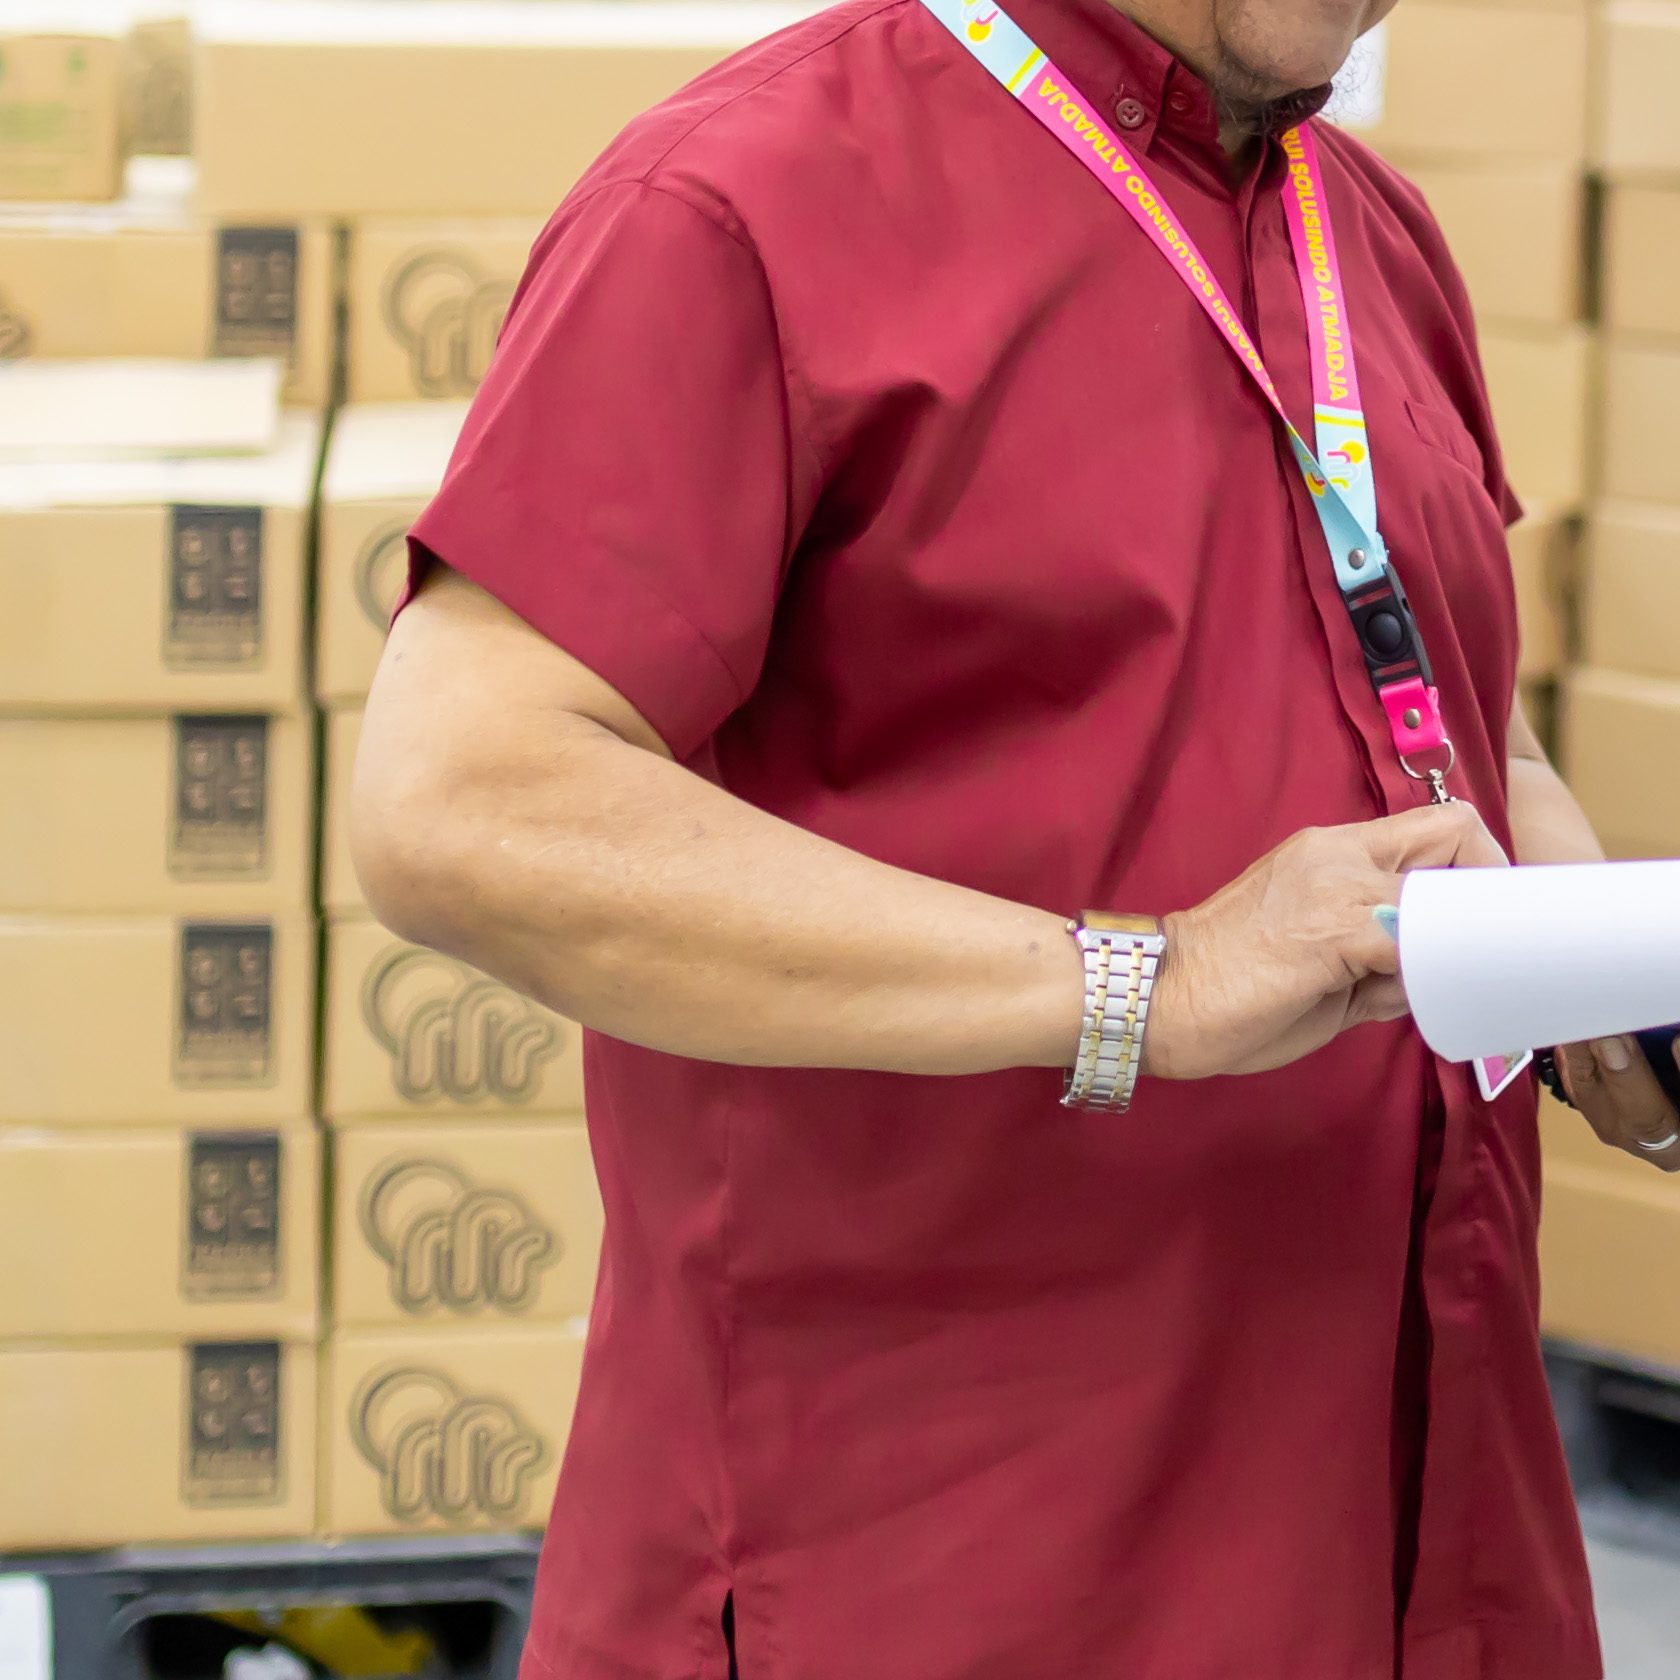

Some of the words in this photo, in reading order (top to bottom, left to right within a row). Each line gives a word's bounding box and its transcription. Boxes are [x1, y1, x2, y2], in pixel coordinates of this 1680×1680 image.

[1038, 77, 1131, 173] ATMADJA
[1281, 127, 1305, 159] RUI
[1125, 175, 1215, 298] SOLUSINDO
[1289, 162, 1332, 284] SOLUSINDO
[1212, 299, 1263, 372] MARUI
[1317, 285, 1349, 402] ATMADJA
